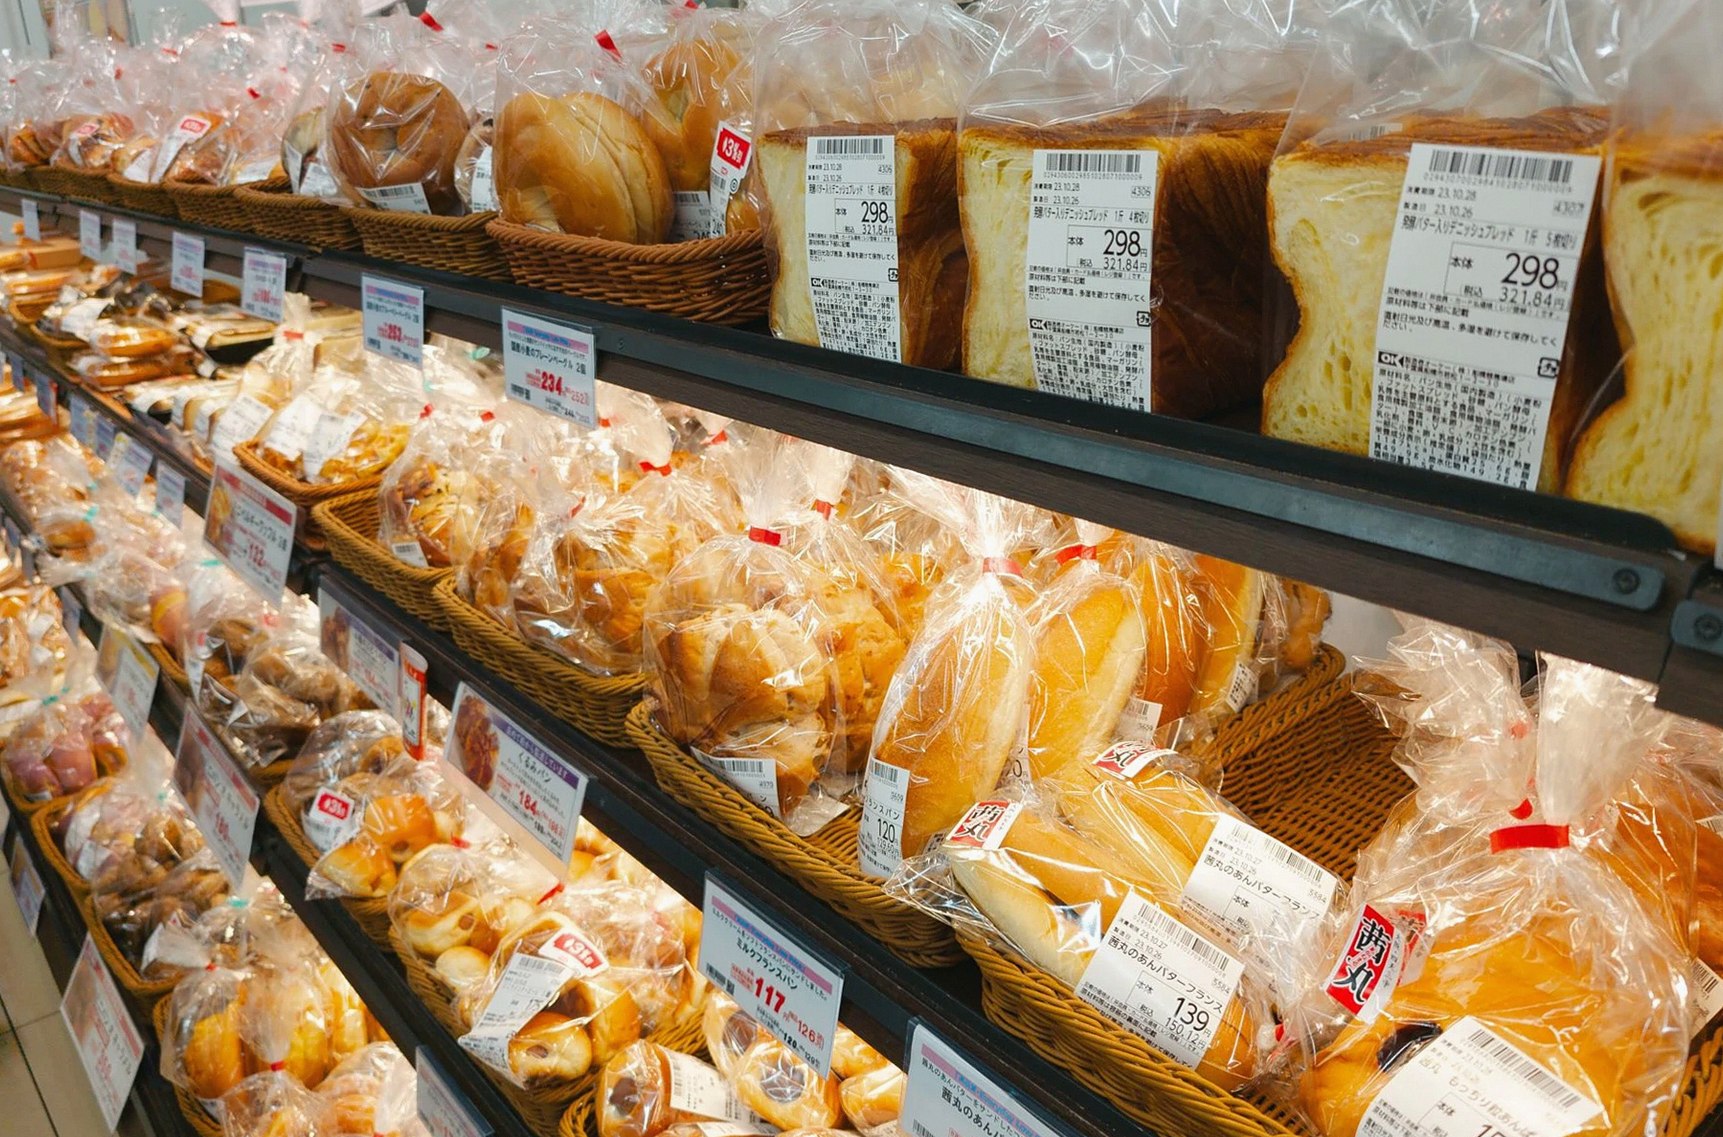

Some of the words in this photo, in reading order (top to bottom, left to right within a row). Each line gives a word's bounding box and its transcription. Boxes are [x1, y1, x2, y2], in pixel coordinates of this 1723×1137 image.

[1451, 256, 1473, 270] 本体
[1500, 287, 1565, 311] 321.84円
[1379, 351, 1402, 366] OK
[541, 371, 563, 396] 234
[519, 789, 538, 817] 184
[736, 936, 798, 990] ミルクフランスパン
[1331, 917, 1391, 1003] 茜丸
[1107, 936, 1223, 1014] 茜丸のあんバターフランス
